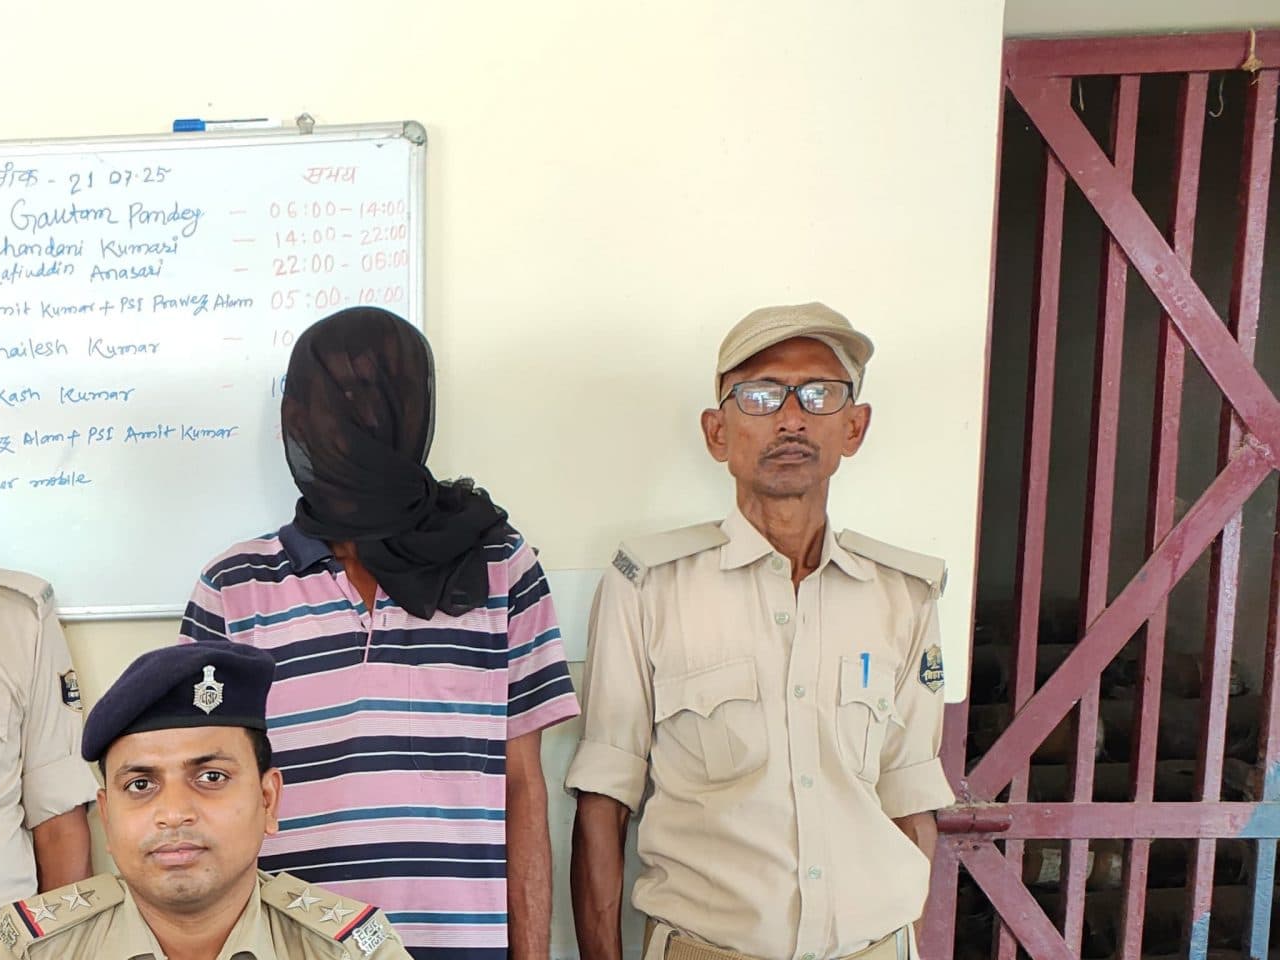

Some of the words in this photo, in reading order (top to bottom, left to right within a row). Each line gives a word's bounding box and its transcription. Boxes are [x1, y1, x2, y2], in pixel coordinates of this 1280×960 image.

[10, 198, 119, 235] Gautam
[127, 200, 205, 238] Pandey
[40, 301, 96, 319] Kumar
[119, 296, 145, 313] PSI
[88, 335, 160, 360] Kumar
[58, 386, 136, 406] Kumar
[86, 427, 115, 445] PSI
[125, 423, 178, 443] Amit
[179, 424, 241, 443] Kumar
